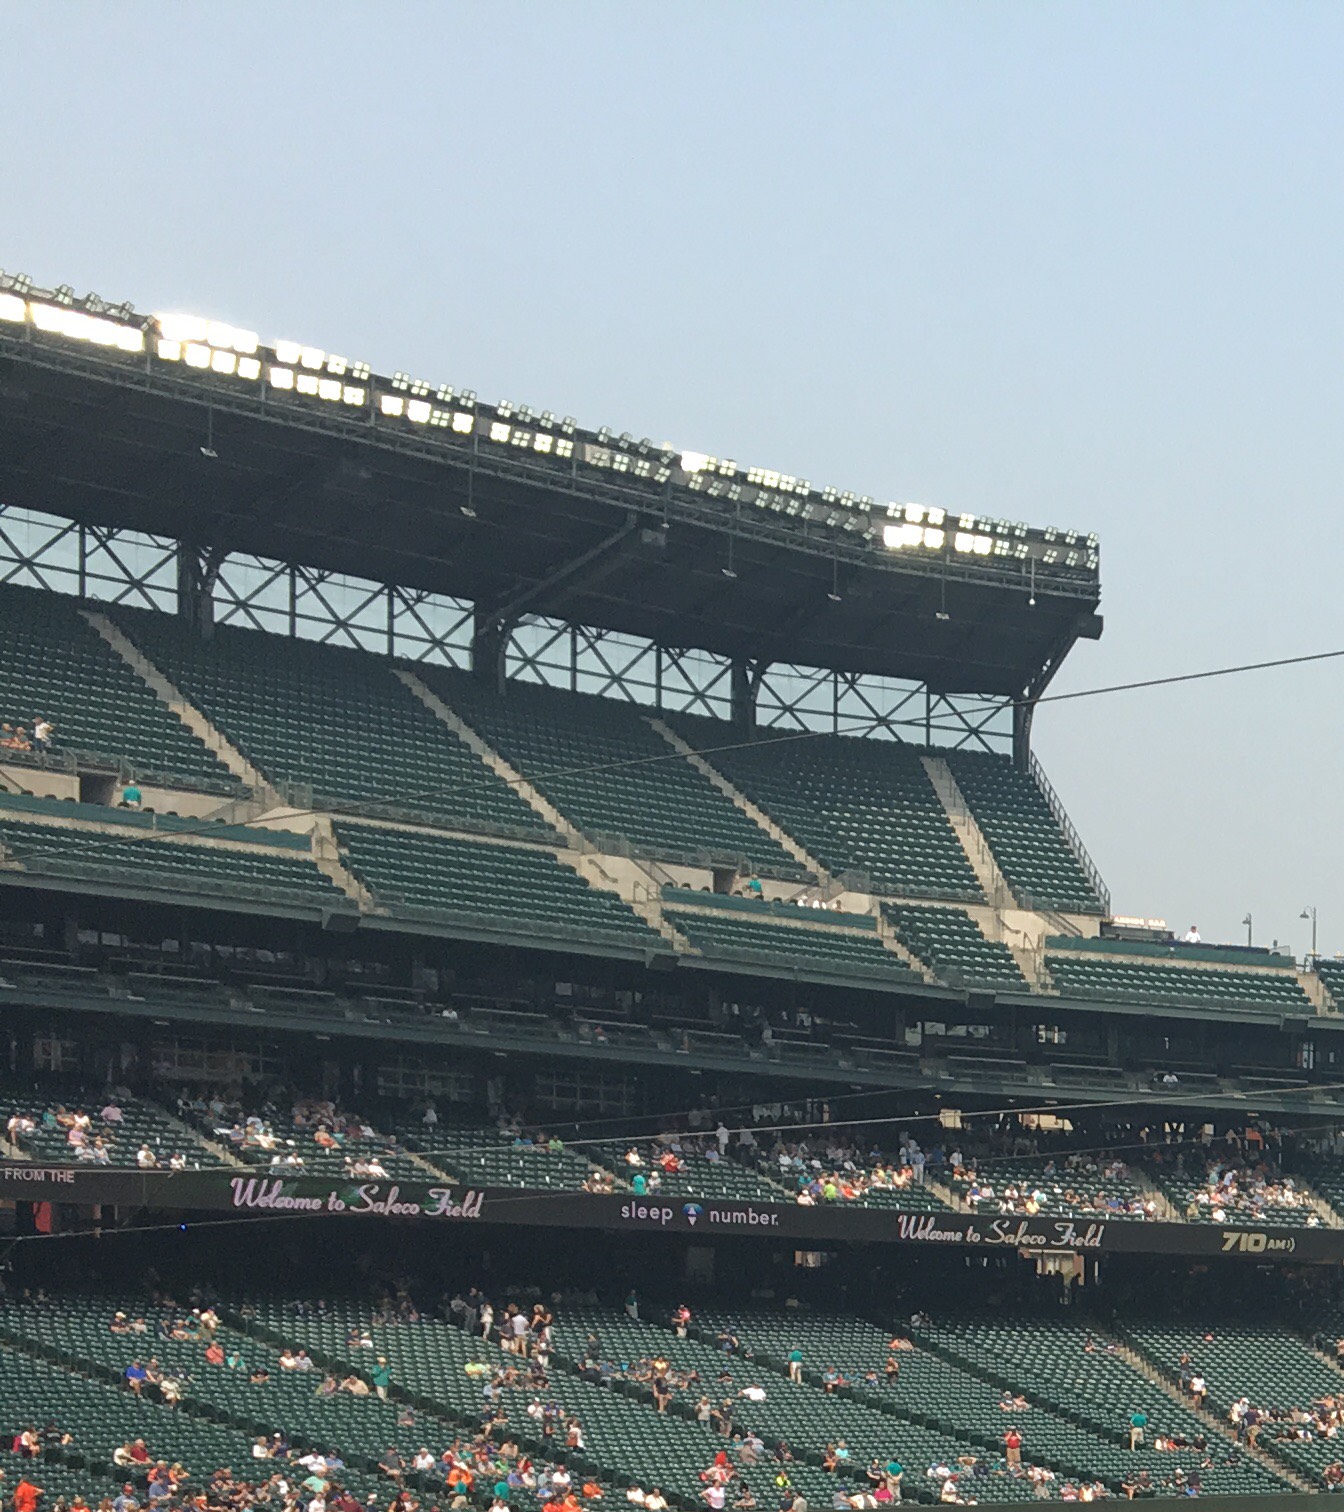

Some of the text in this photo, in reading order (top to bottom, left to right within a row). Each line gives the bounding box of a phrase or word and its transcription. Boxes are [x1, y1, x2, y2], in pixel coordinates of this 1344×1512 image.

[4, 1167, 76, 1184] FROM THE
[230, 1177, 485, 1219] Welcome to Safeco Field
[620, 1201, 674, 1226] sleep
[897, 1215, 1105, 1248] Welcome to Safeco Field
[1221, 1231, 1269, 1253] 710
